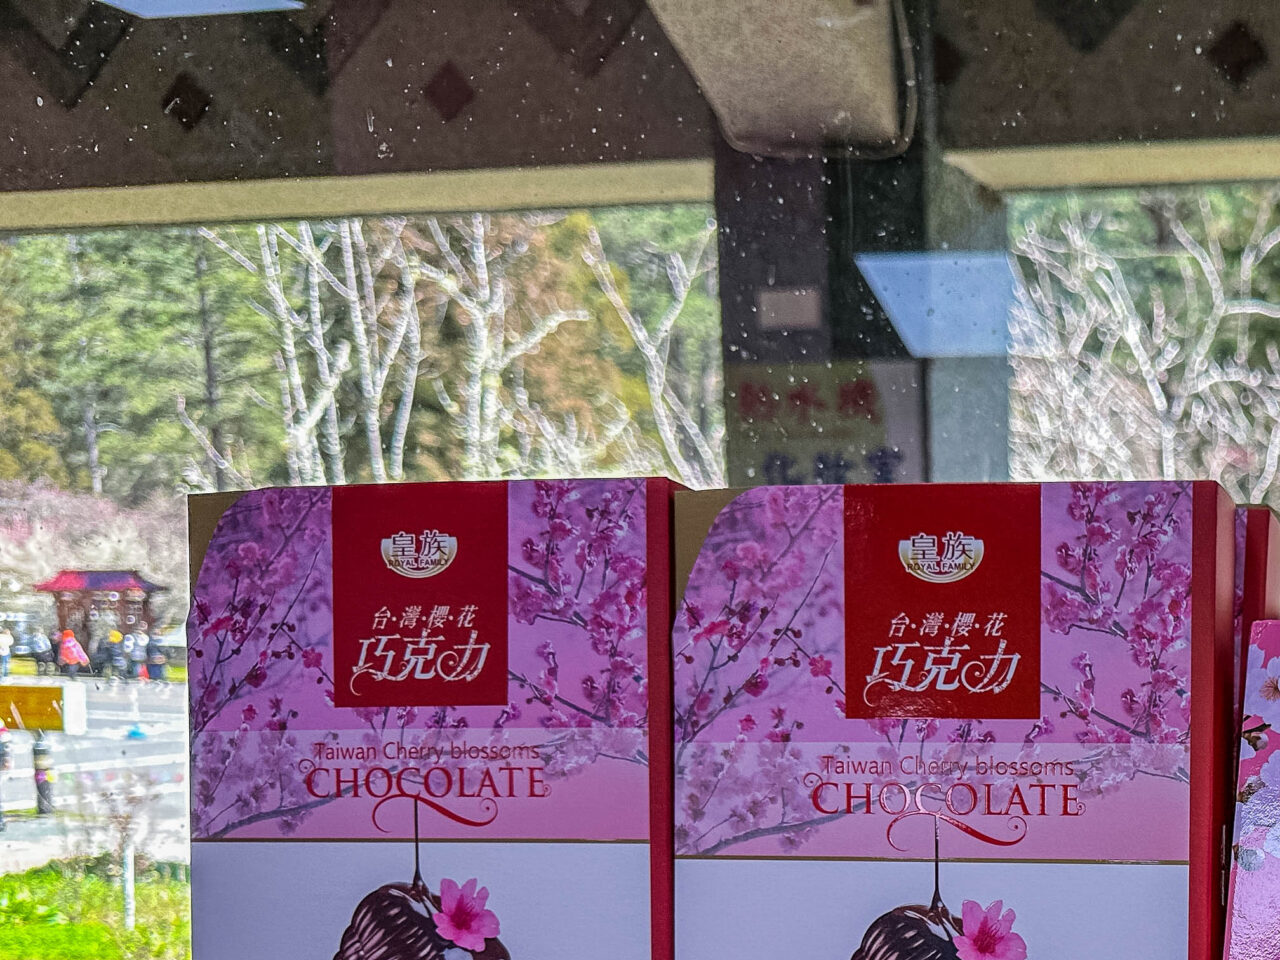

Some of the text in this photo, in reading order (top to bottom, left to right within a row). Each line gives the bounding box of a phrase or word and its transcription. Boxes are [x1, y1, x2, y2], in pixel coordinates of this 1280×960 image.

[391, 530, 449, 560] 皇族
[910, 531, 976, 562] 皇族
[388, 557, 449, 569] ROYAL FAMILY
[907, 561, 975, 572] ROYAL FAMILY
[350, 629, 491, 696] 巧克力
[864, 638, 1022, 707] 巧克力
[314, 742, 540, 763] Taiwan Cherry blossoms
[299, 761, 552, 802] CHOCOLATE
[822, 756, 1075, 780] Taiwan Cherry blossoms
[804, 774, 1086, 819] CHOCOLATE
